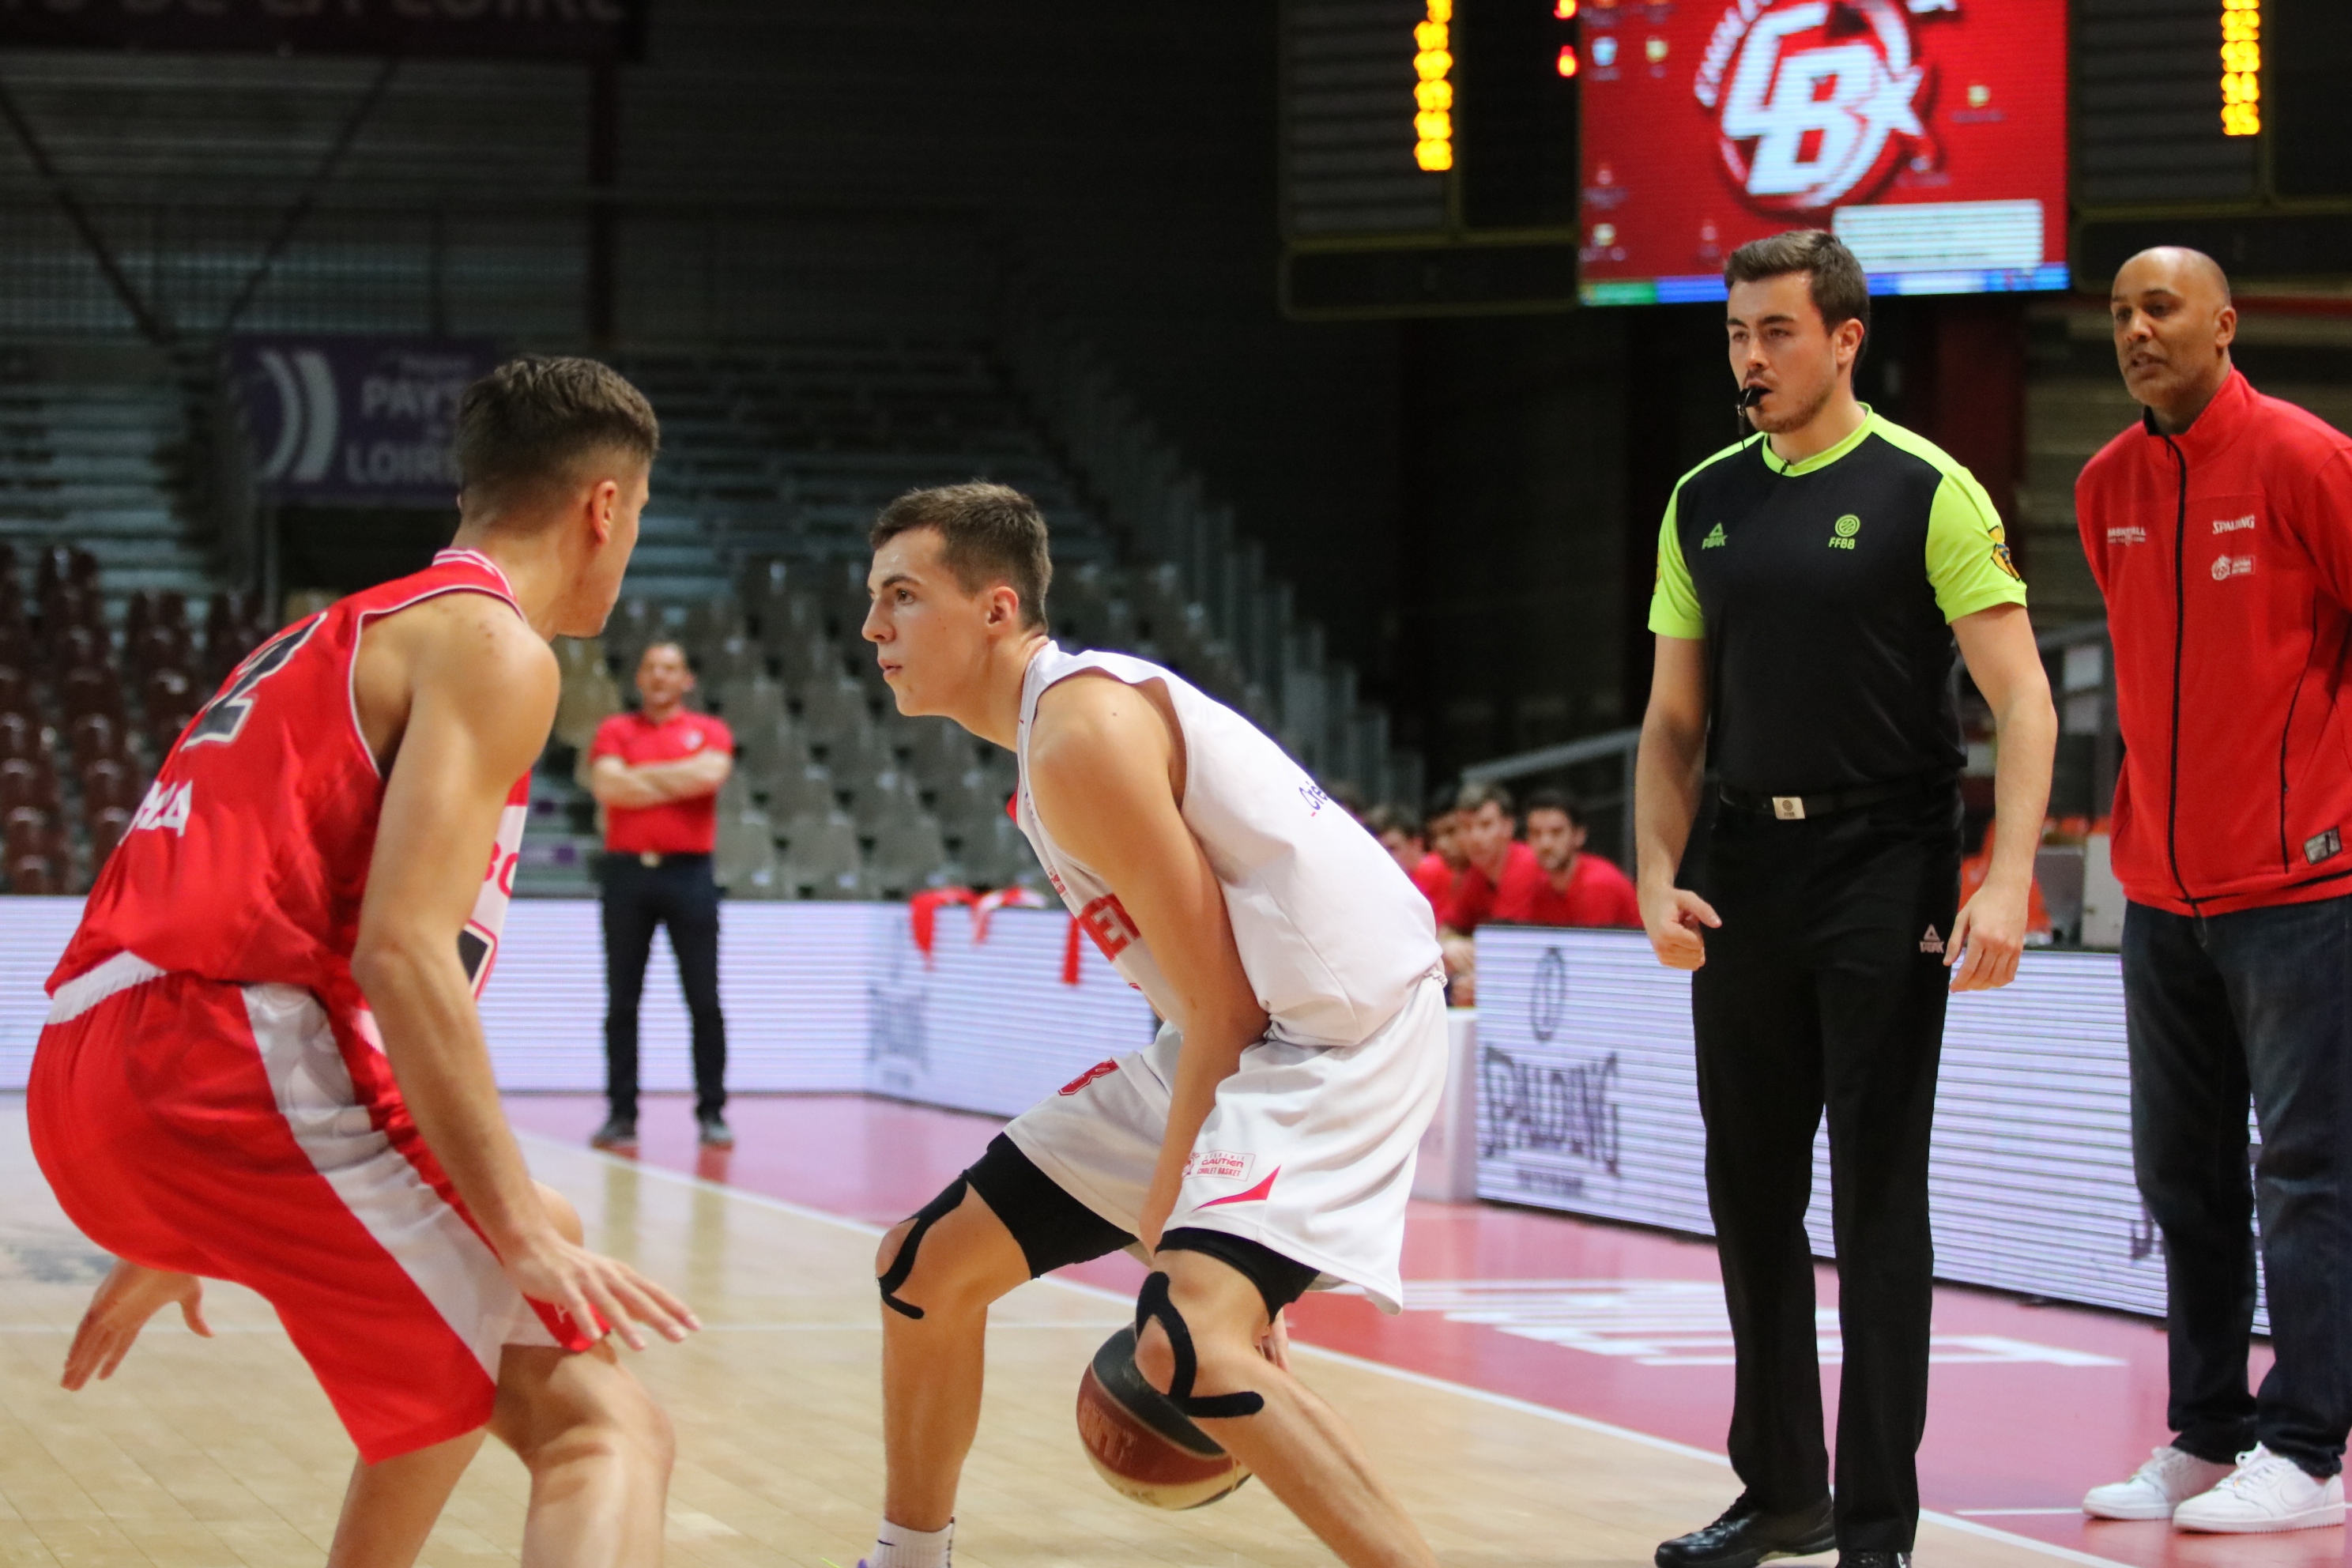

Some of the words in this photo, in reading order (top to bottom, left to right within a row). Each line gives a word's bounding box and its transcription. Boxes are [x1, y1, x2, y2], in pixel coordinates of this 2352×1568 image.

[2212, 514, 2256, 535] SPALDING
[1828, 537, 1856, 550] FFBB
[1200, 1158, 1245, 1169] GAUTIER
[1217, 1167, 1242, 1178] BASKET
